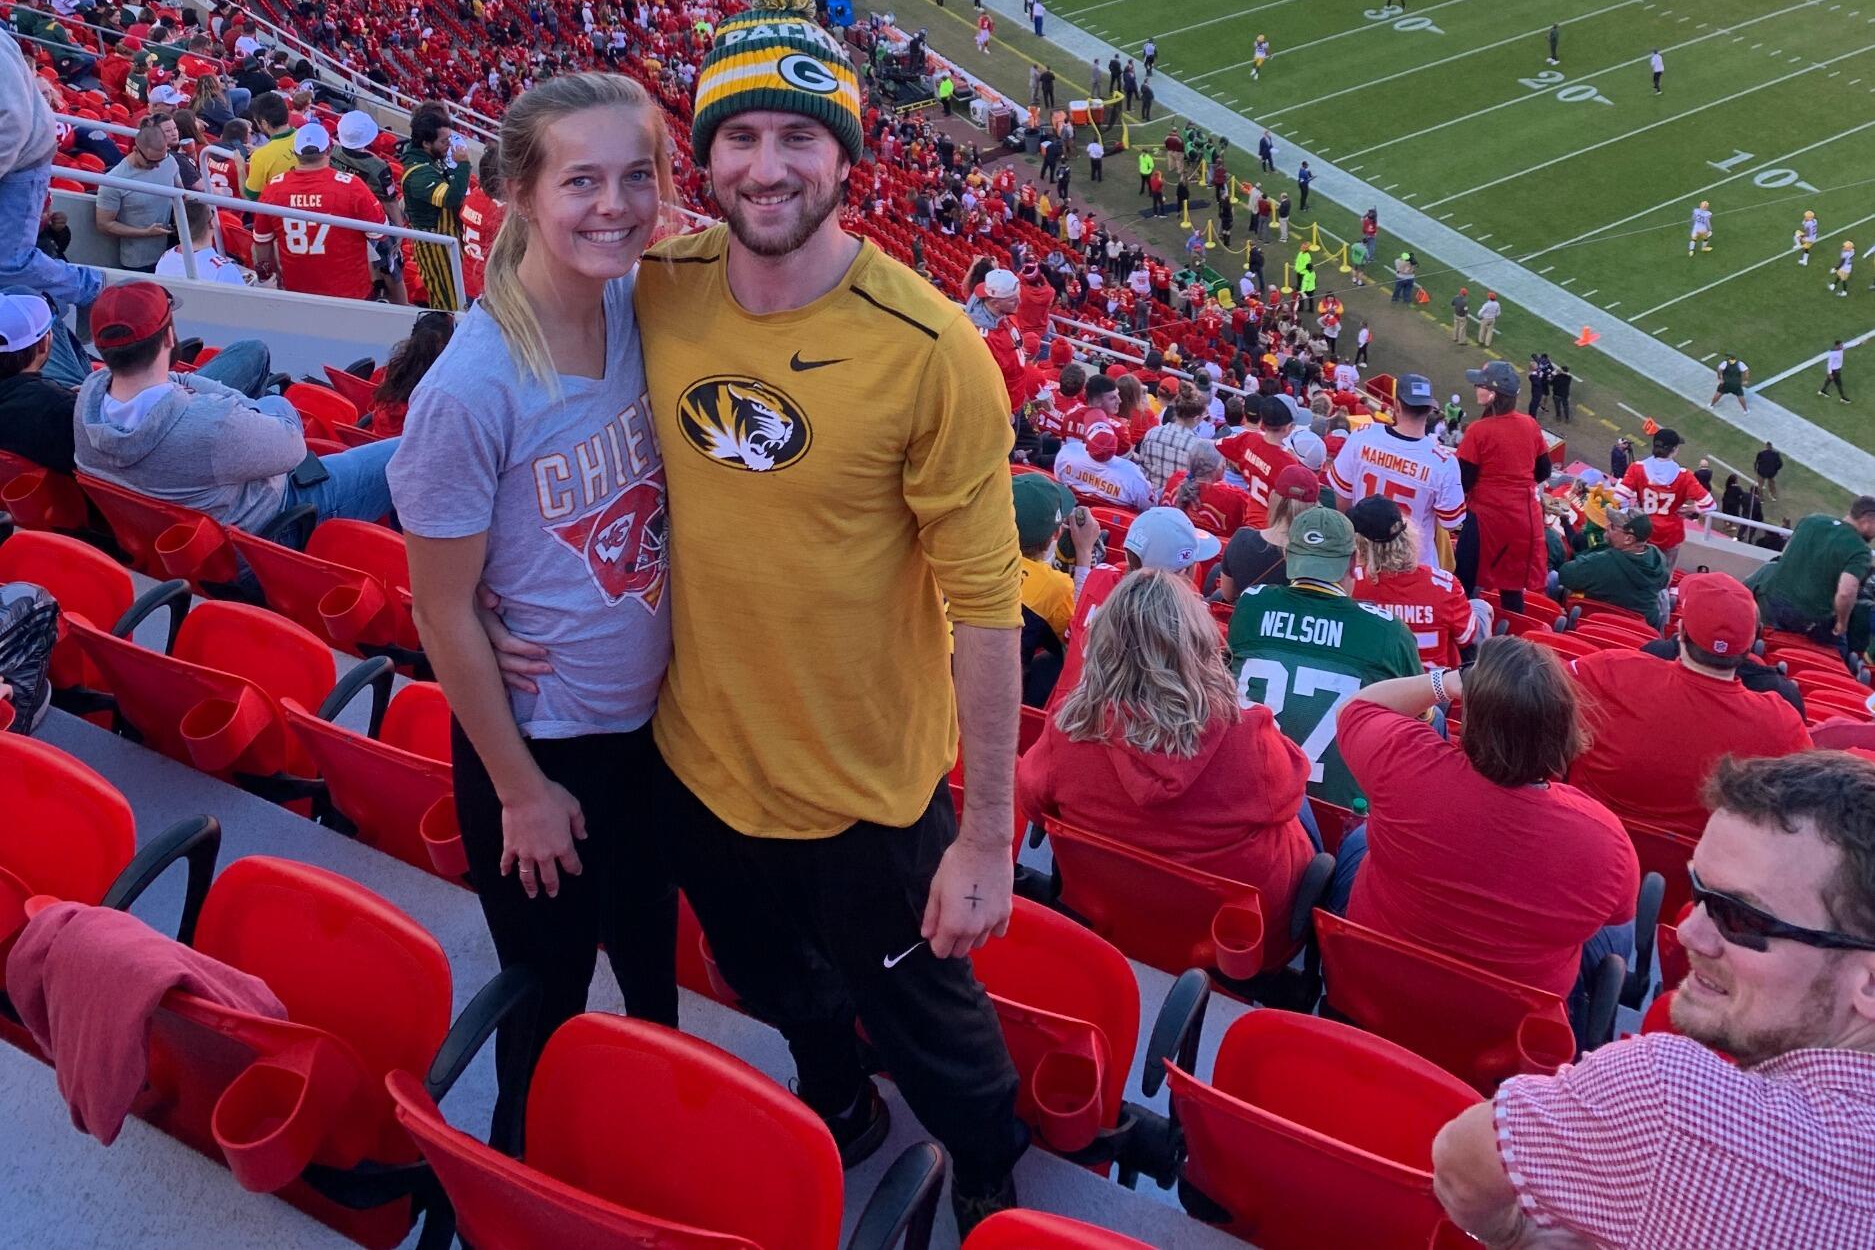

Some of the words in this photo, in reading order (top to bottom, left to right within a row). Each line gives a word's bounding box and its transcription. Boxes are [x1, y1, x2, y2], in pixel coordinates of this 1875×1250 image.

[1364, 4, 1434, 33] 30
[778, 54, 839, 95] G
[1518, 70, 1600, 104] 20
[1706, 149, 1802, 188] 10
[290, 194, 322, 207] KELCE
[283, 215, 331, 255] 87
[1244, 449, 1272, 477] MAHOMES
[1361, 446, 1417, 478] MAHOMES
[1421, 466, 1430, 482] II
[1075, 471, 1121, 498] JOHNSON
[1363, 472, 1416, 517] 15
[1643, 488, 1675, 515] 87
[1304, 531, 1325, 545] G
[1432, 567, 1454, 593] 15
[1260, 611, 1344, 648] NELSON
[1238, 658, 1361, 783] 87
